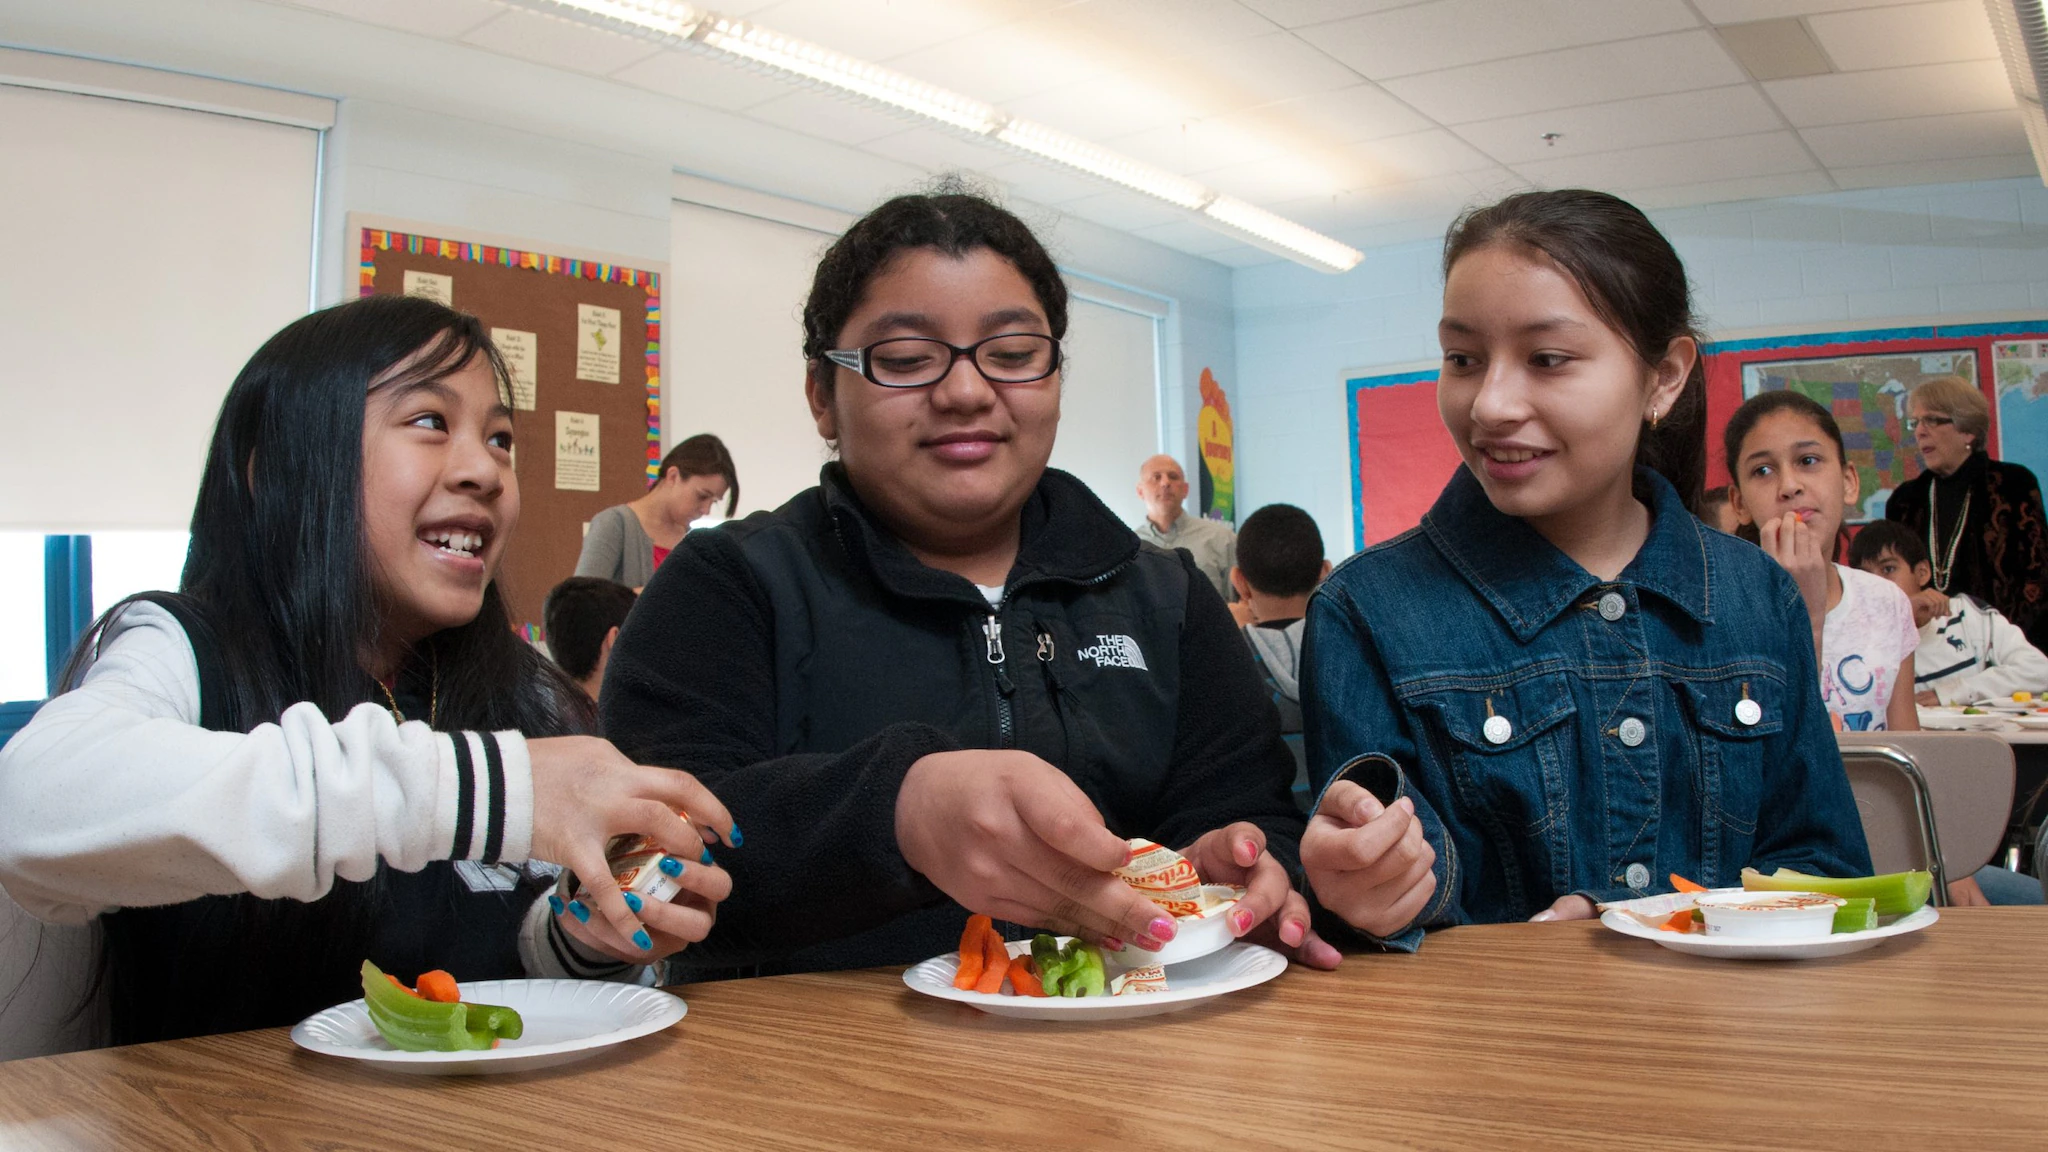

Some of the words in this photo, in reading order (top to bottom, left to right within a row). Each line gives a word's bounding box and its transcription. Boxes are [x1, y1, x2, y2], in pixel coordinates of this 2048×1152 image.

[1096, 634, 1124, 646] THE
[1077, 645, 1126, 661] NORTH
[1095, 655, 1130, 667] FACE
